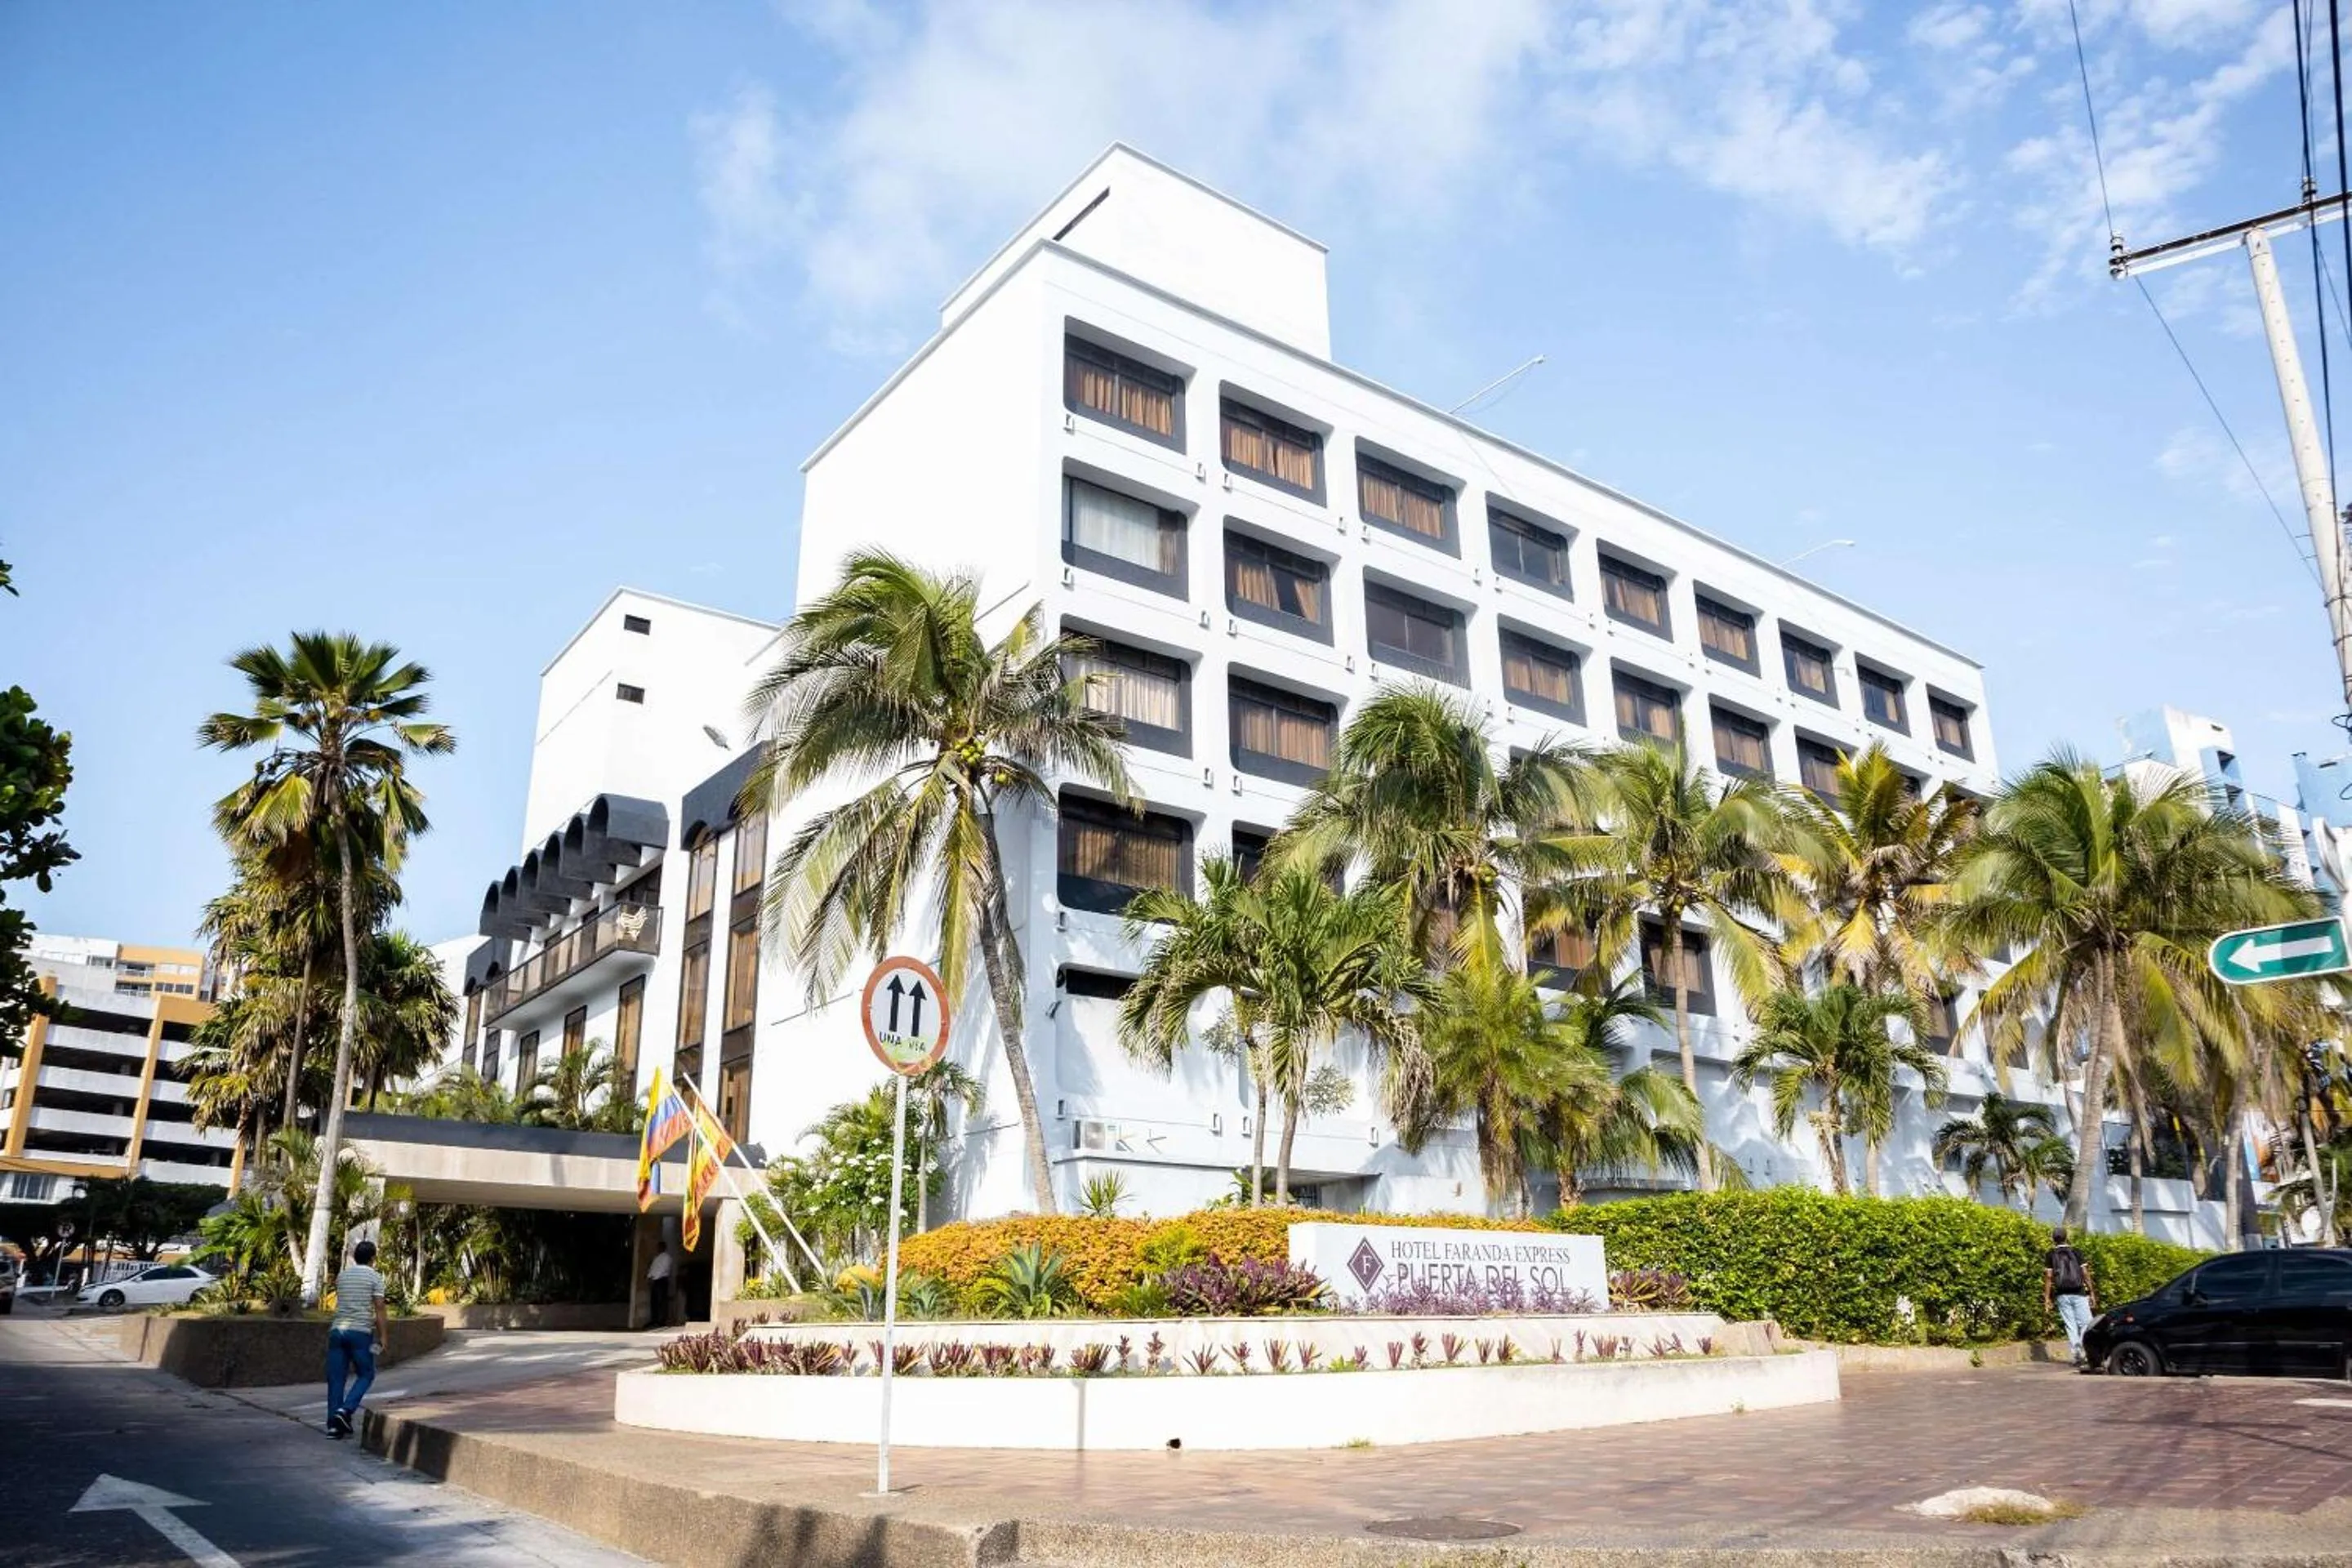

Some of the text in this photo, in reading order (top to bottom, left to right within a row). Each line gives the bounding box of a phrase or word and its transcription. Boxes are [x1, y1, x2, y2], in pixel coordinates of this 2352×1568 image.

[879, 1031, 902, 1045] UNA
[1391, 1241, 1570, 1264] HOTEL FARANDA EXPRESS
[1397, 1263, 1477, 1296] PUERTA
[1530, 1266, 1571, 1297] SOL
